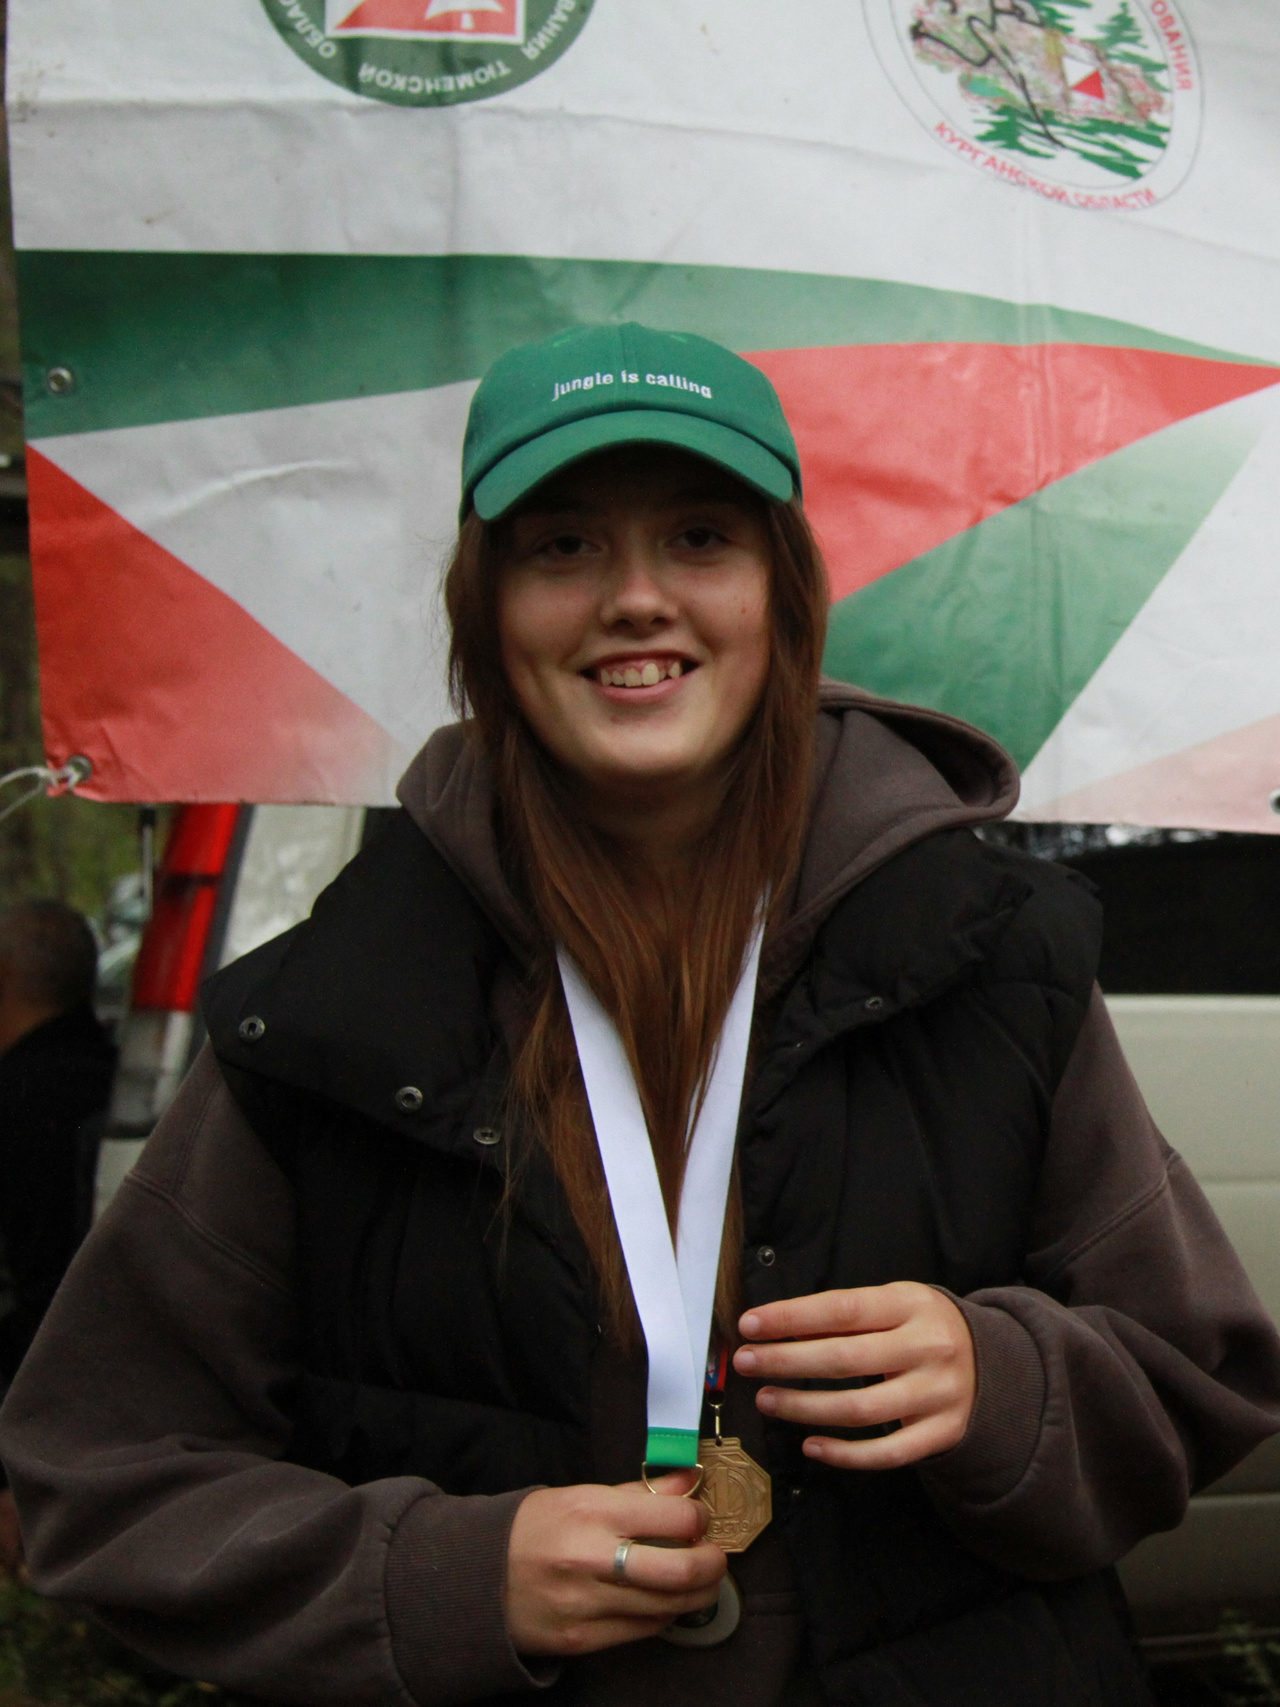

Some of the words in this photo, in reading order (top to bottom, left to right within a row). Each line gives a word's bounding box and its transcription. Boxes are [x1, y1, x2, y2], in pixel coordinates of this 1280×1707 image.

[358, 60, 511, 93] ТЮМЕНСКОЙ
[552, 372, 614, 401] jungle
[621, 370, 639, 383] is
[646, 373, 712, 399] calling
